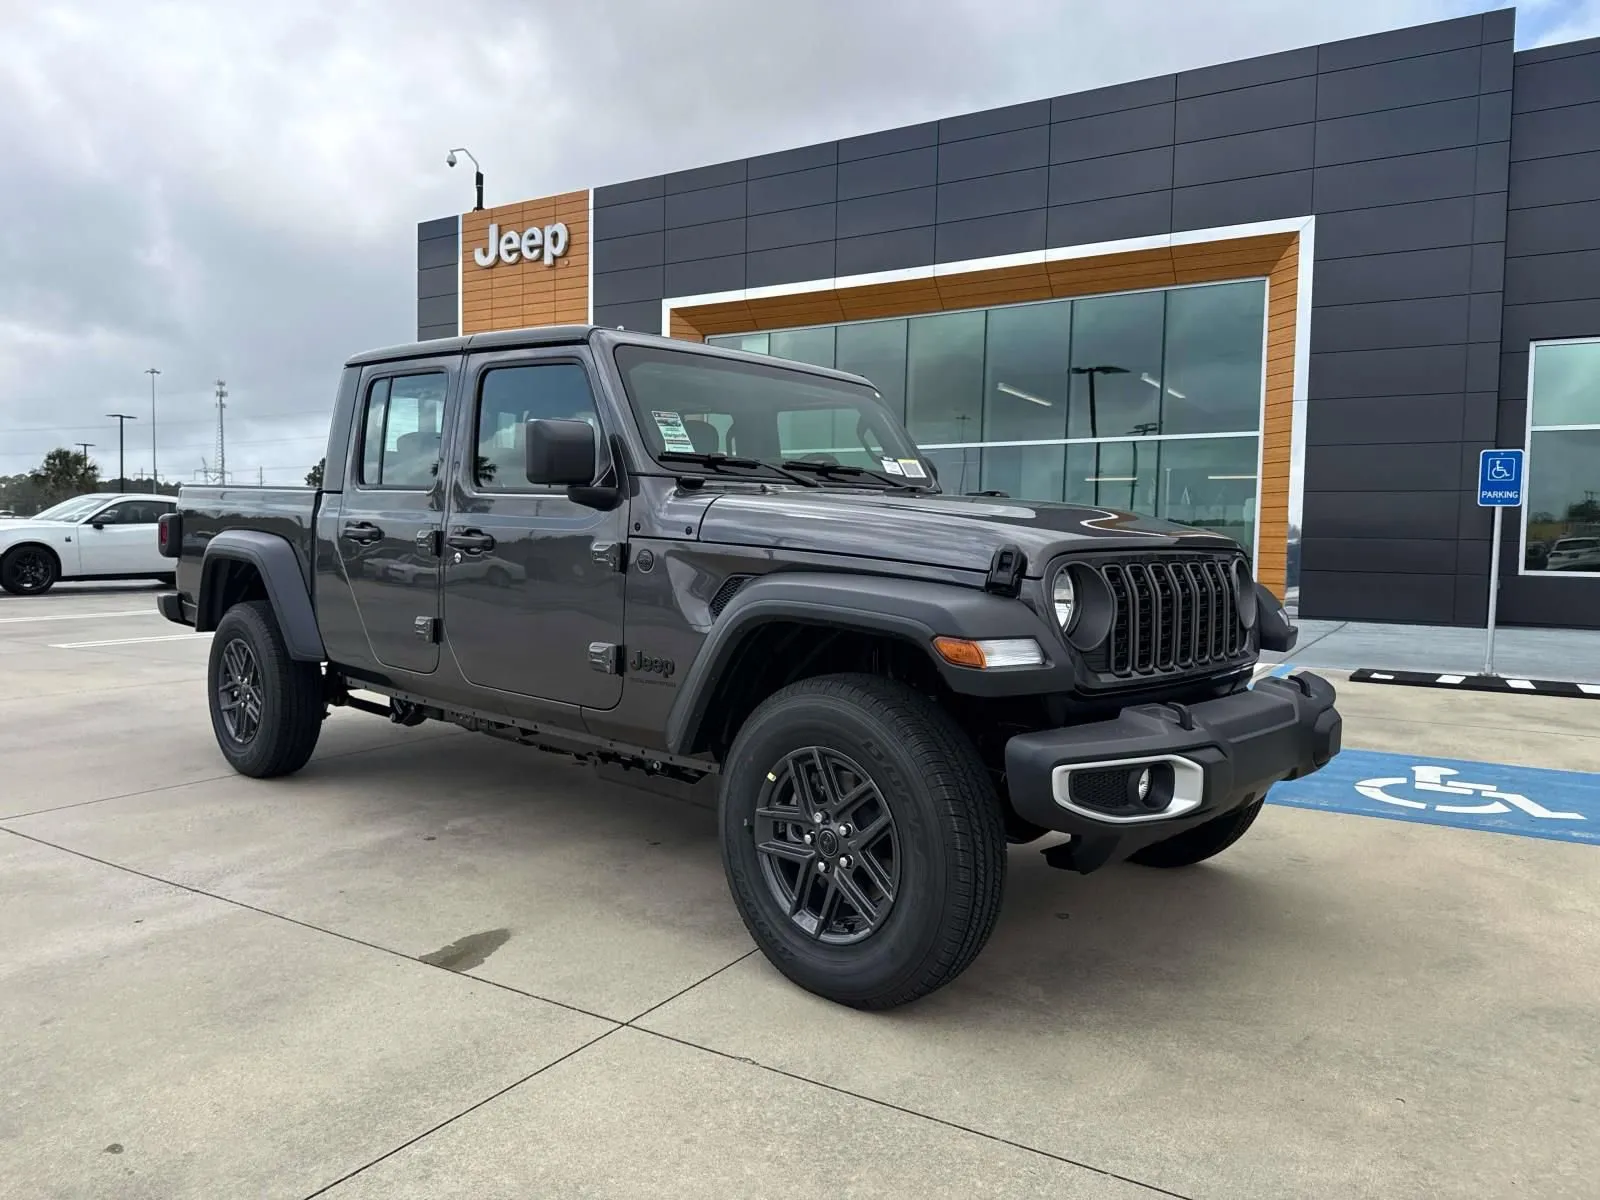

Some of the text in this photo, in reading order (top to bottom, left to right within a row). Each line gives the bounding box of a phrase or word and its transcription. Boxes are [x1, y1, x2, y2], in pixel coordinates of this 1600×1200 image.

[474, 222, 569, 268] Jeep
[1481, 490, 1519, 499] PARKING
[630, 650, 675, 678] Jeep
